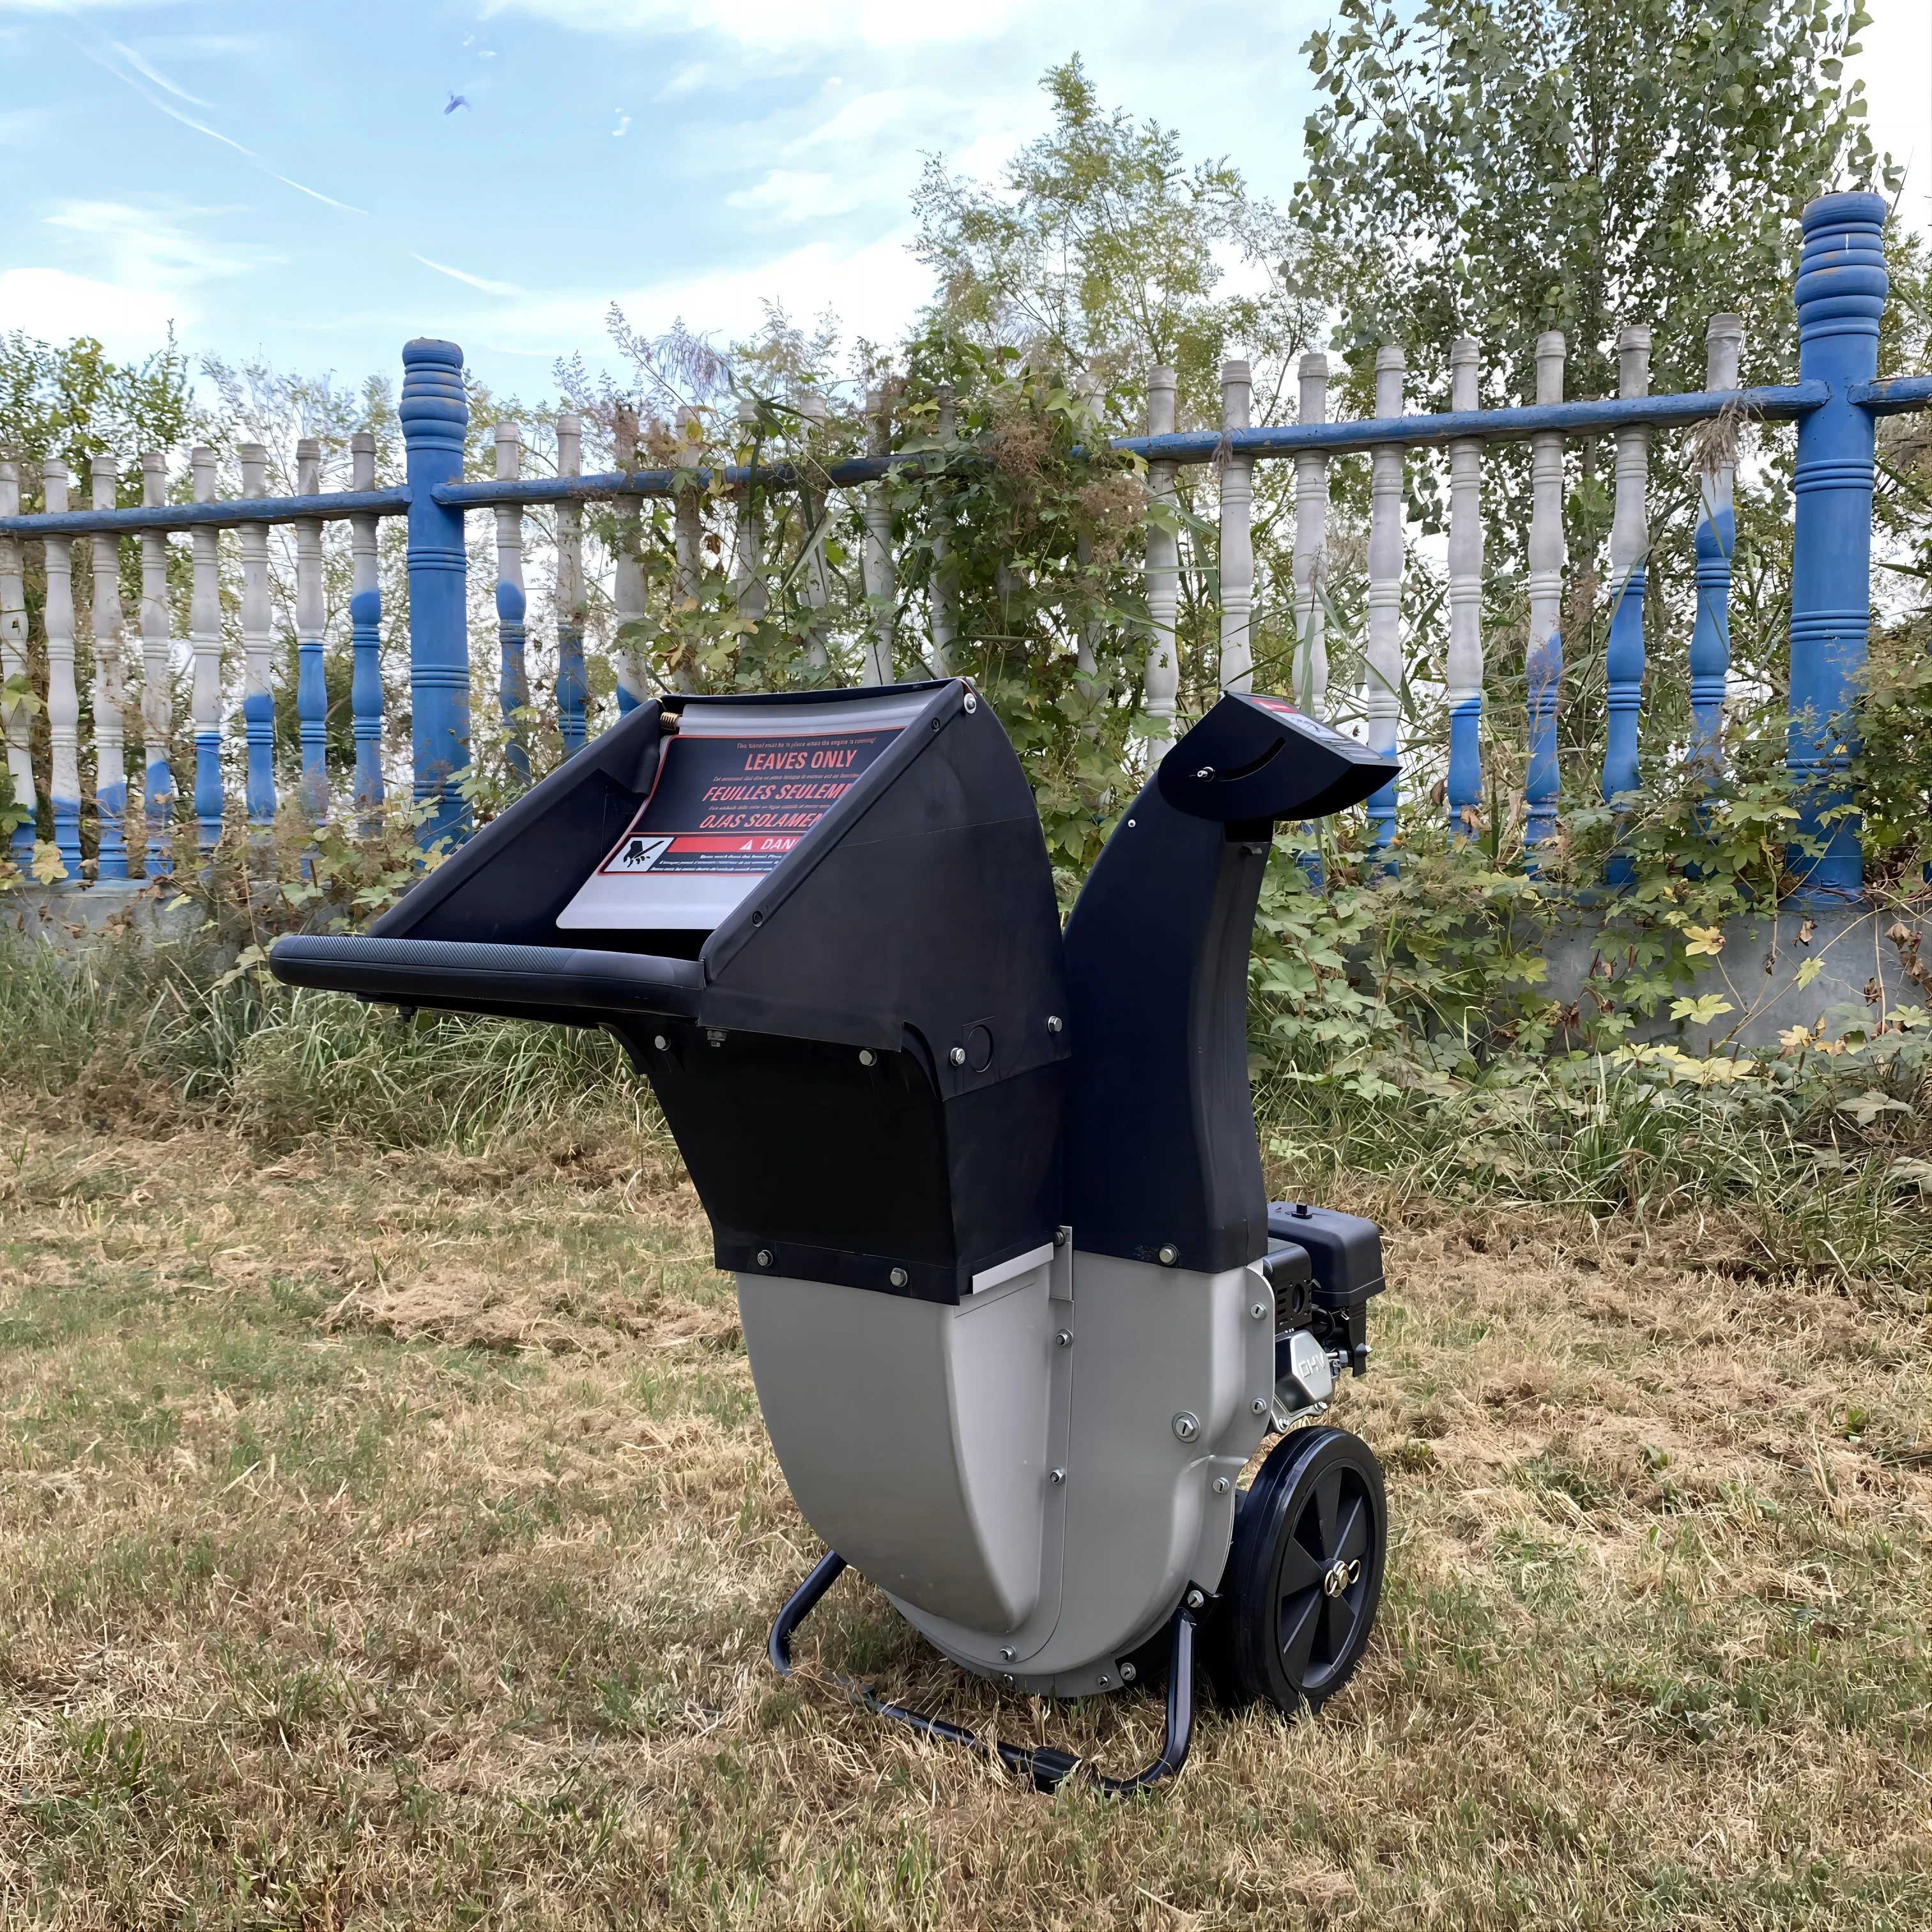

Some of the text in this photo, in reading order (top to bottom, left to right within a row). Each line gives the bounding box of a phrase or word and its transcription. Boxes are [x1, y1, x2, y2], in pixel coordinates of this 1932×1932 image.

[744, 749, 858, 771] LEAVES ONLY
[702, 784, 777, 802] FEUILLES
[699, 813, 746, 829] OJAS
[760, 838, 799, 850] DAN
[1298, 1351, 1325, 1378] OHV
